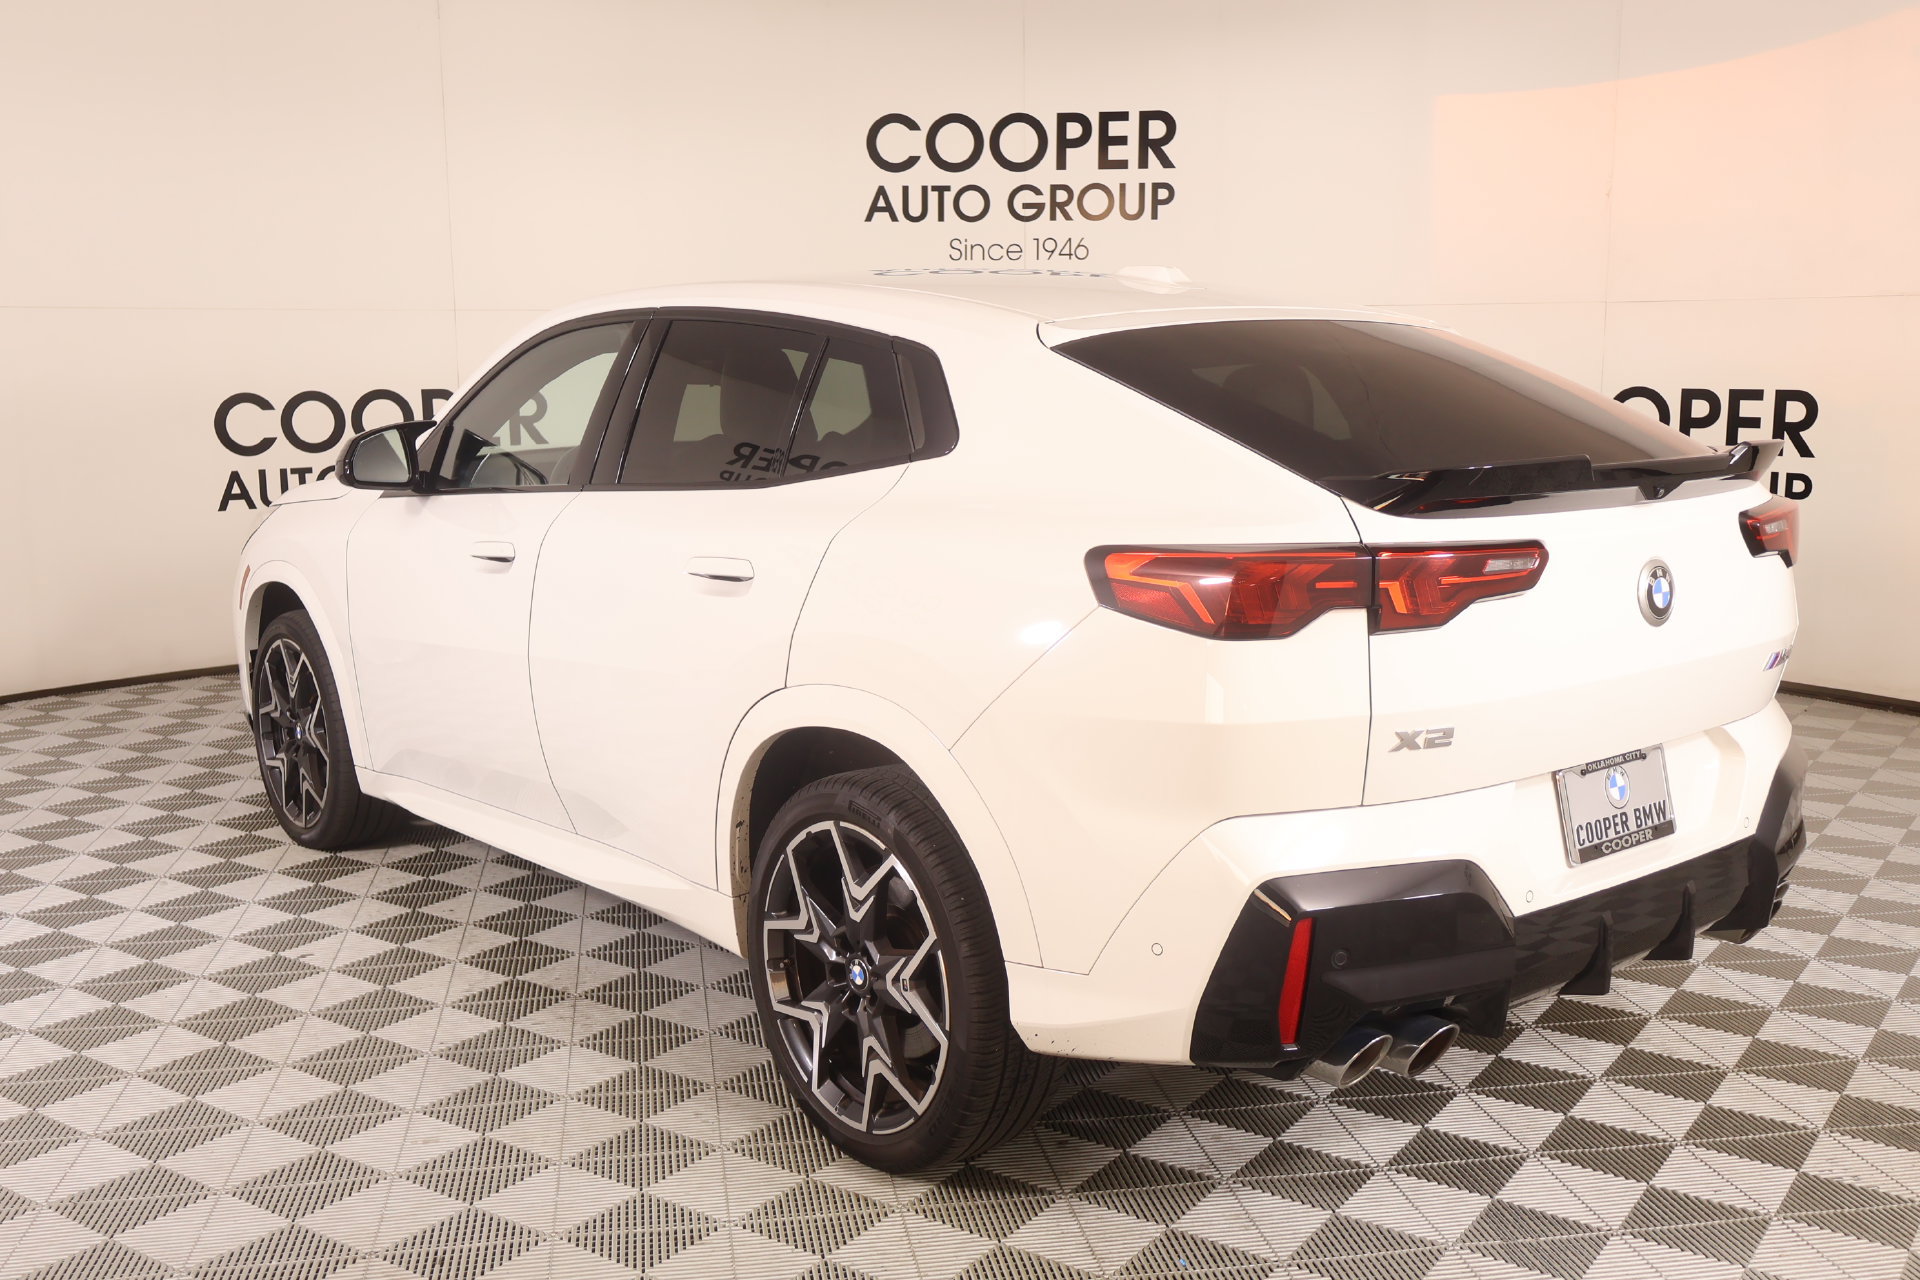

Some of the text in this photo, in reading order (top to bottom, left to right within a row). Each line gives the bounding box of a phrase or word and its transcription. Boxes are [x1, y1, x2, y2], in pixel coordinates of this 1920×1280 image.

[866, 110, 1177, 173] COOPER
[864, 182, 1175, 222] AUTO GROUP
[949, 237, 1089, 261] Since 1946
[218, 466, 336, 512] AUT
[1387, 727, 1455, 752] X2
[1587, 750, 1641, 772] OKLAHOMA CITY
[1576, 800, 1667, 847] COOPER BMW
[1601, 829, 1654, 854] COOPER
